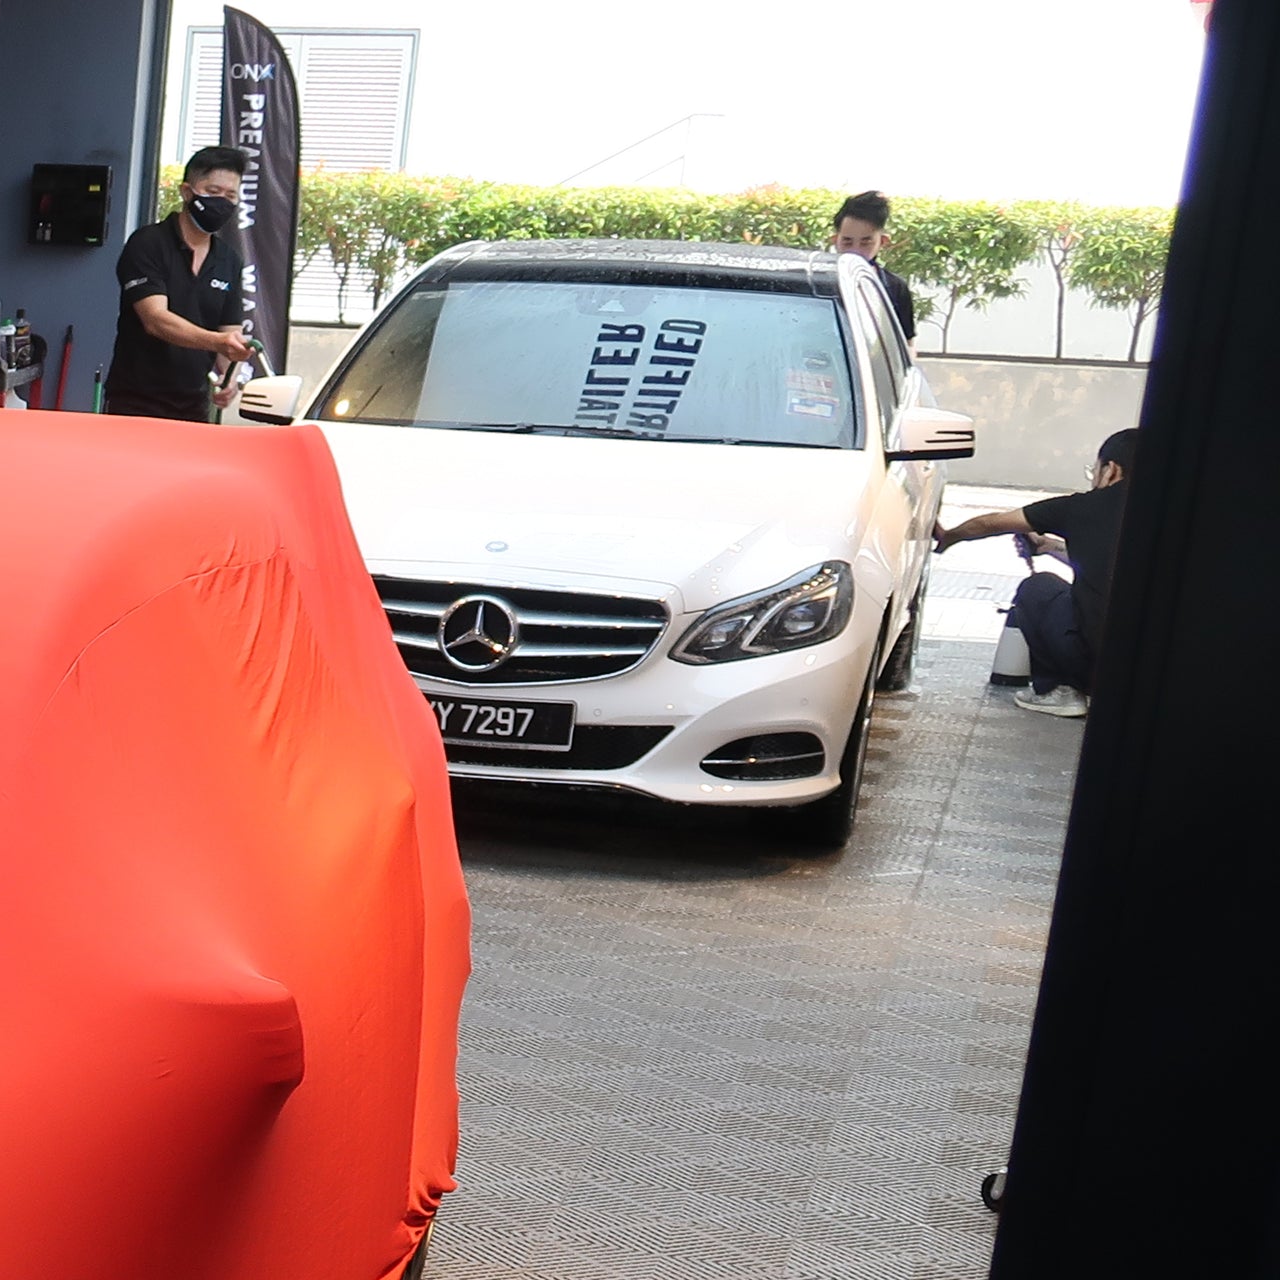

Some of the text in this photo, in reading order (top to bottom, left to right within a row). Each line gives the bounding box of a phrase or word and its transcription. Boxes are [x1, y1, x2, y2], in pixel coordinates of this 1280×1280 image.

[231, 64, 275, 82] ONX
[238, 94, 265, 229] PREMIUM
[431, 701, 534, 737] Y 7297
